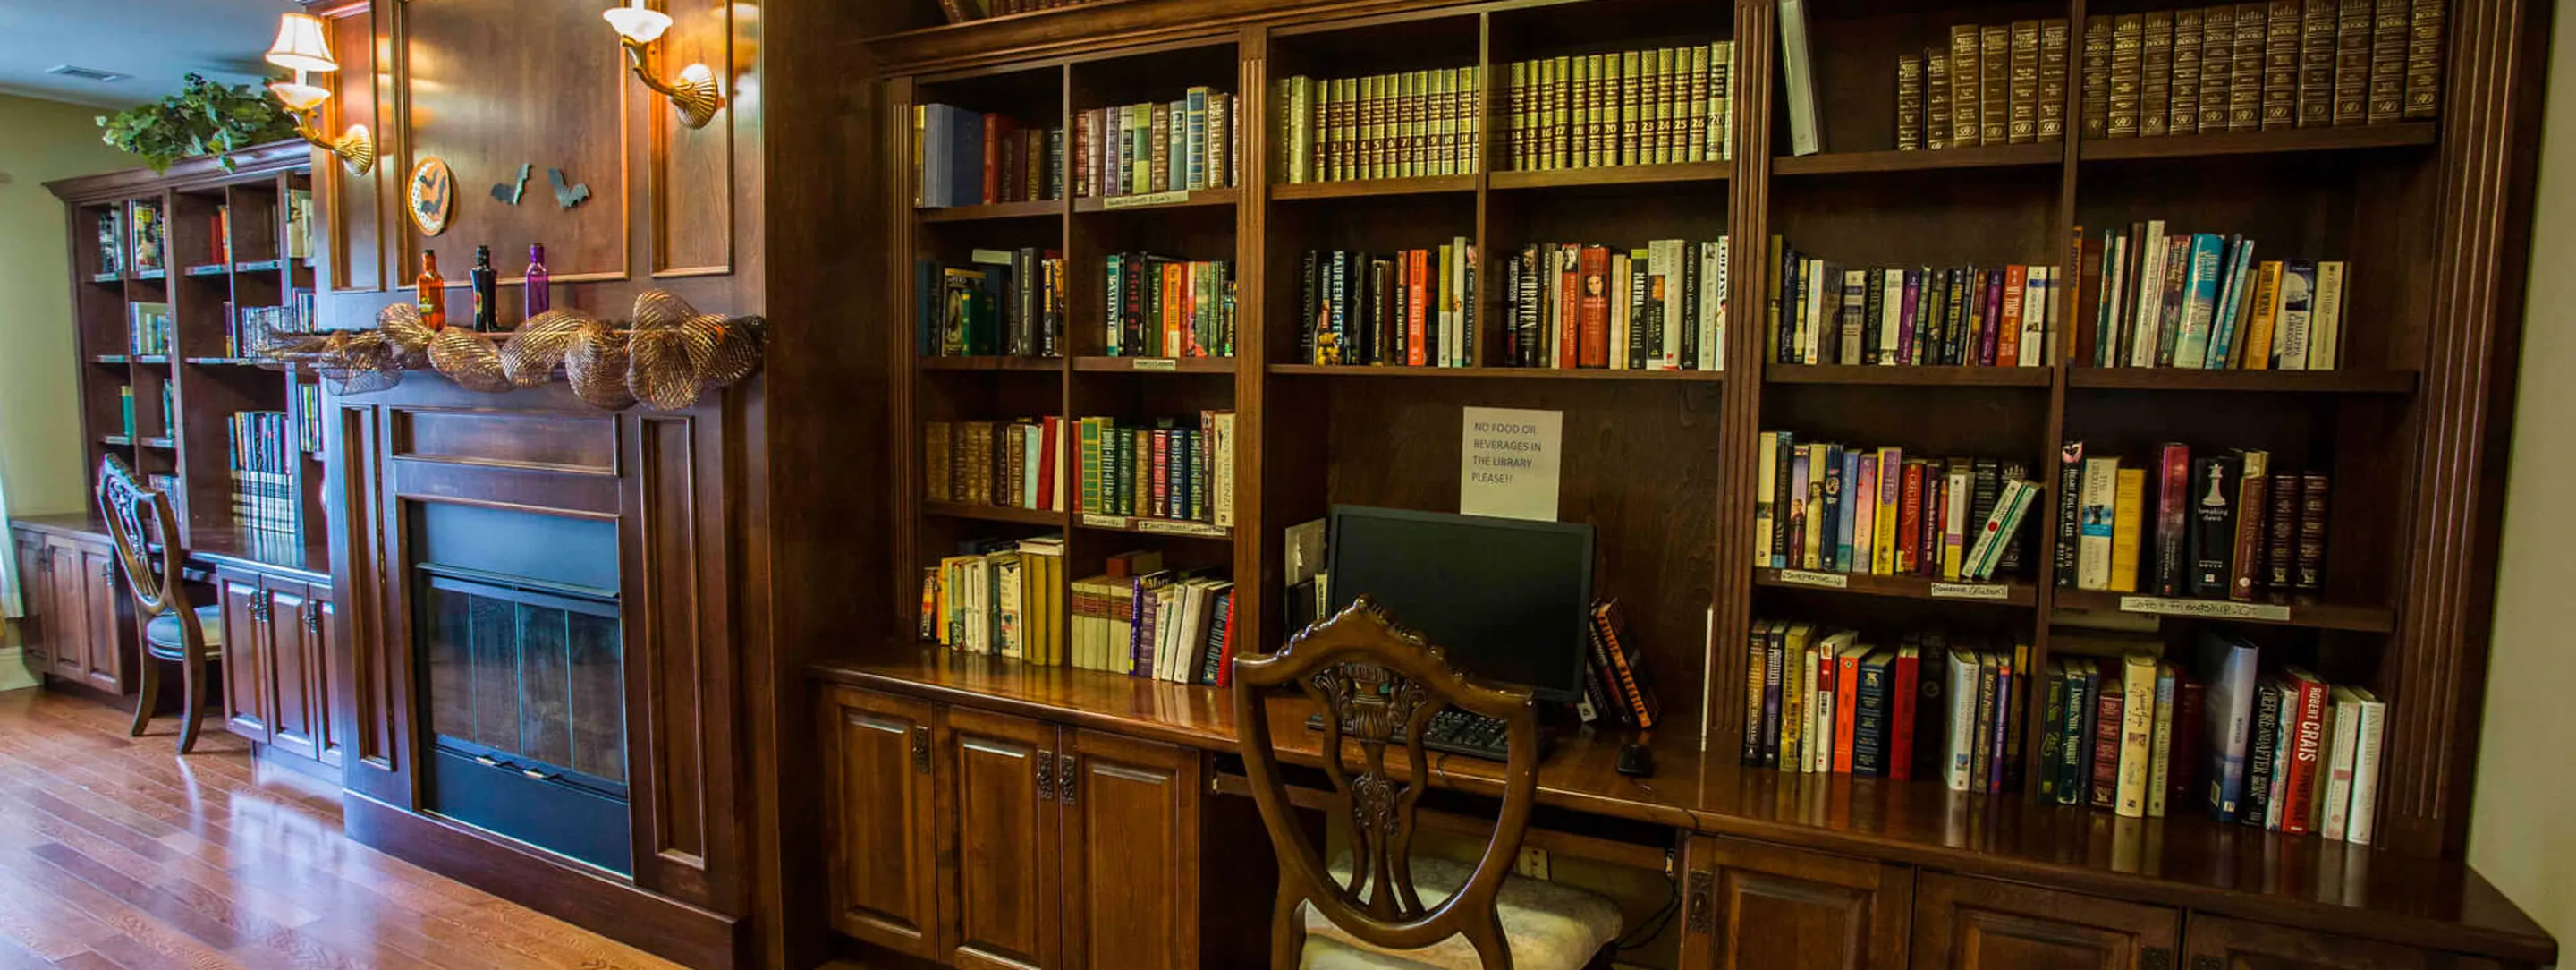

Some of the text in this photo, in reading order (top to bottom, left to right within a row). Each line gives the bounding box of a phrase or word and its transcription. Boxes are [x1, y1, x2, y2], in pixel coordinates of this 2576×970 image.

[1333, 250, 1344, 301] MAUREEN
[1474, 422, 1536, 435] NO FOOD OR
[1473, 438, 1542, 452] BEVERAGES IN
[1472, 455, 1533, 468] THE LIBRARY
[2305, 686, 2323, 720] ROBERT
[2297, 721, 2321, 762] CRAIS
